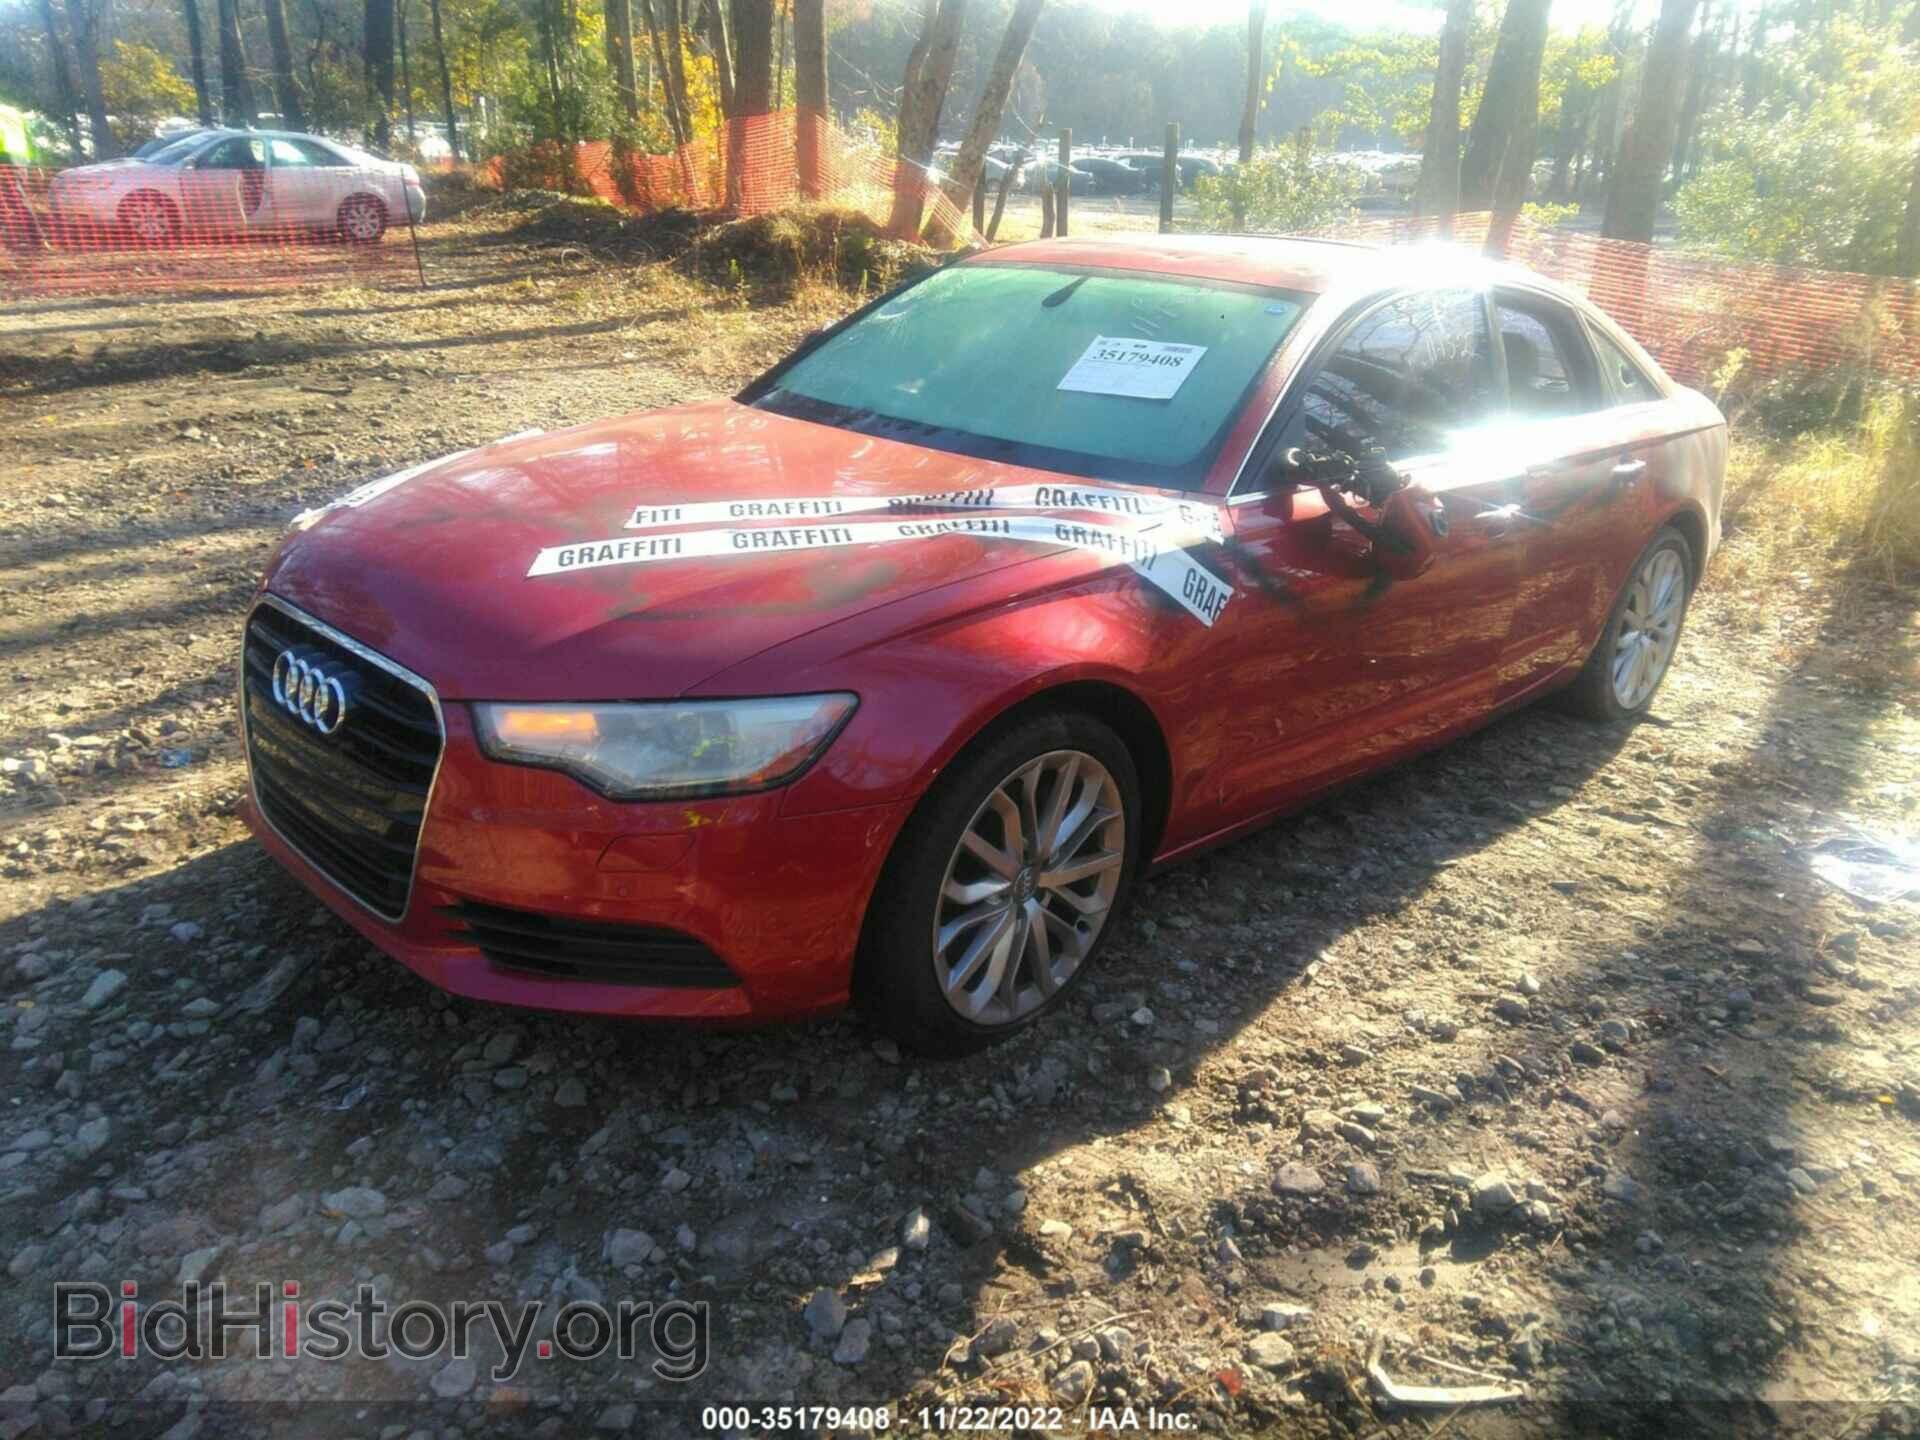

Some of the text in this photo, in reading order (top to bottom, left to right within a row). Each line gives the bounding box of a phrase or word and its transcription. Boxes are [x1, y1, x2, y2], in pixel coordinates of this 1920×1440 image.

[1092, 349, 1184, 368] 35179408
[635, 508, 681, 525] FITI
[729, 500, 843, 518] GRAFFITI
[1034, 487, 1143, 515] GRAFFITI
[557, 537, 682, 567] GRAFFITI
[731, 527, 853, 550] GRAFFITI
